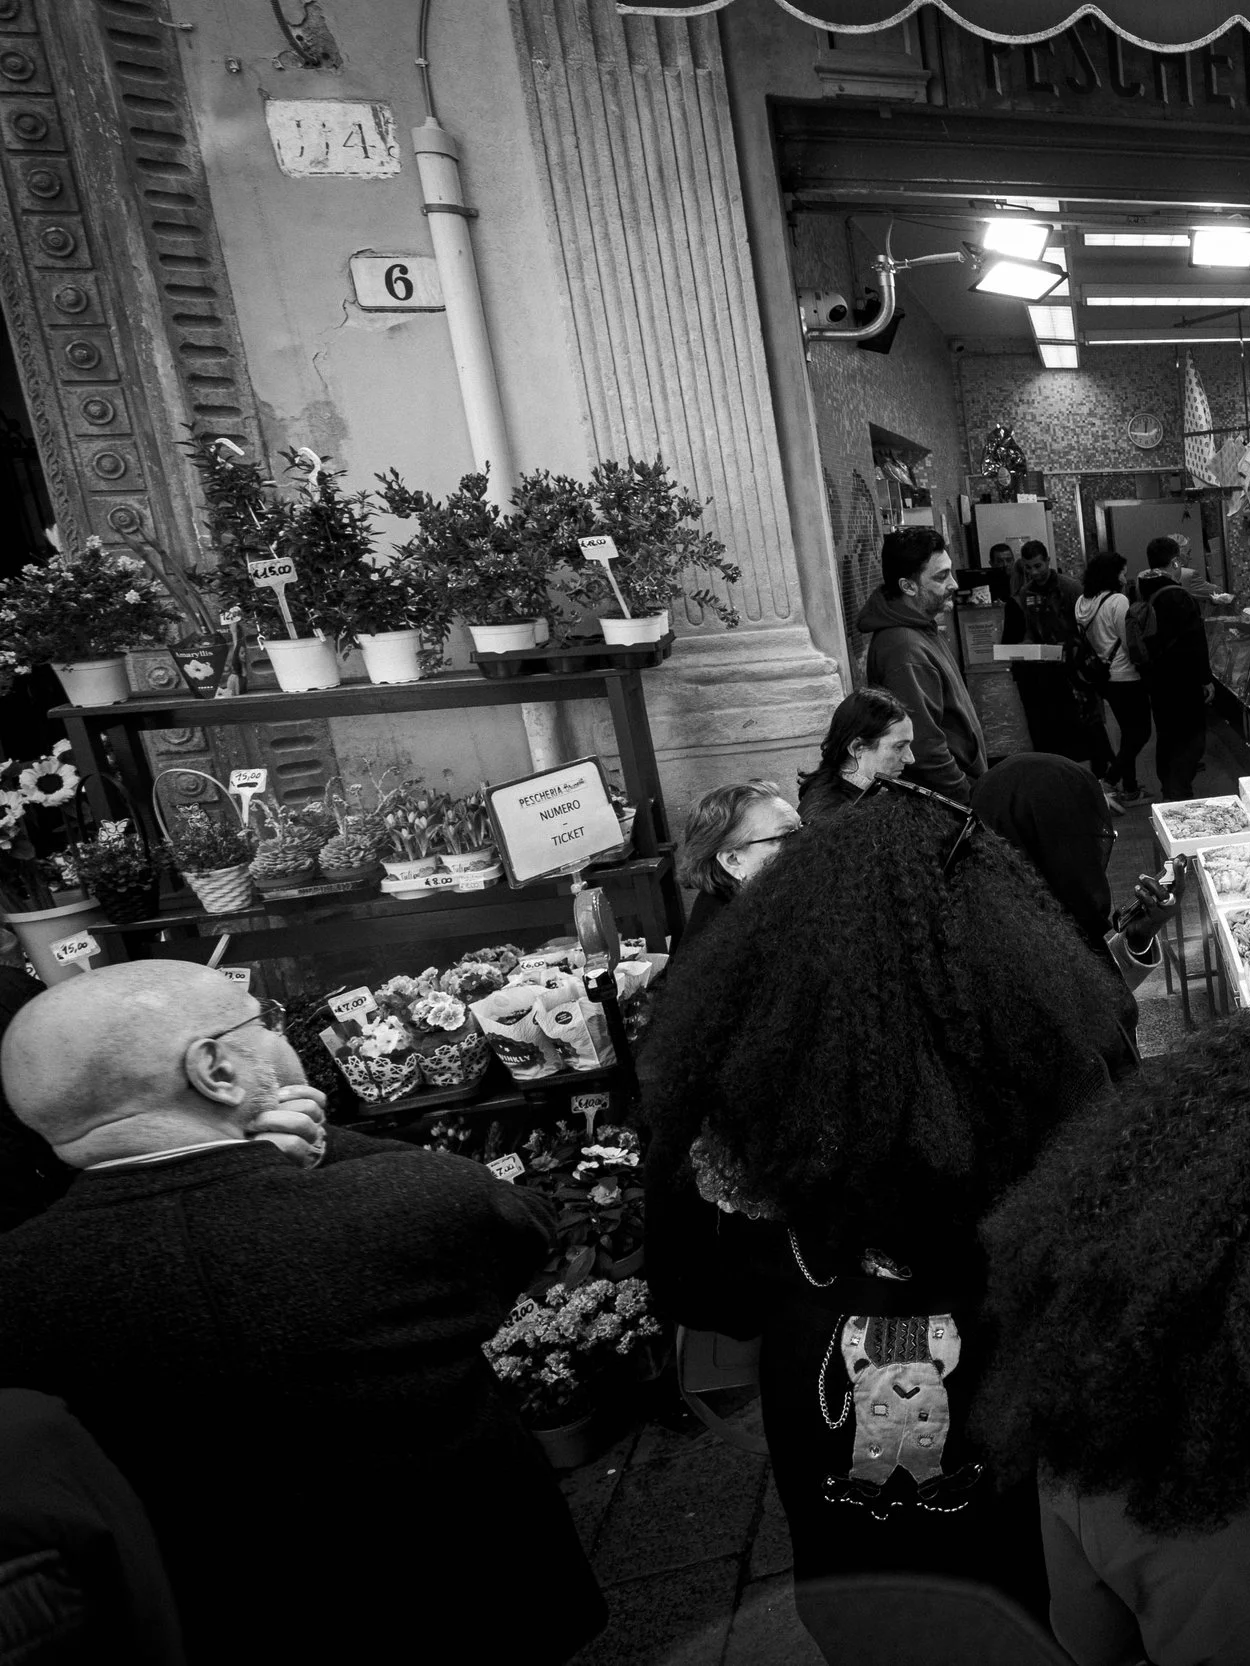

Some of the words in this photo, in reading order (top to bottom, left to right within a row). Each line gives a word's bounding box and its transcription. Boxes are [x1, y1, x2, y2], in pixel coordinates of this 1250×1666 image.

[385, 264, 413, 300] 6
[518, 786, 562, 808] PESCHERIA
[540, 799, 581, 821] NUMERO
[551, 826, 585, 847] TICKET
